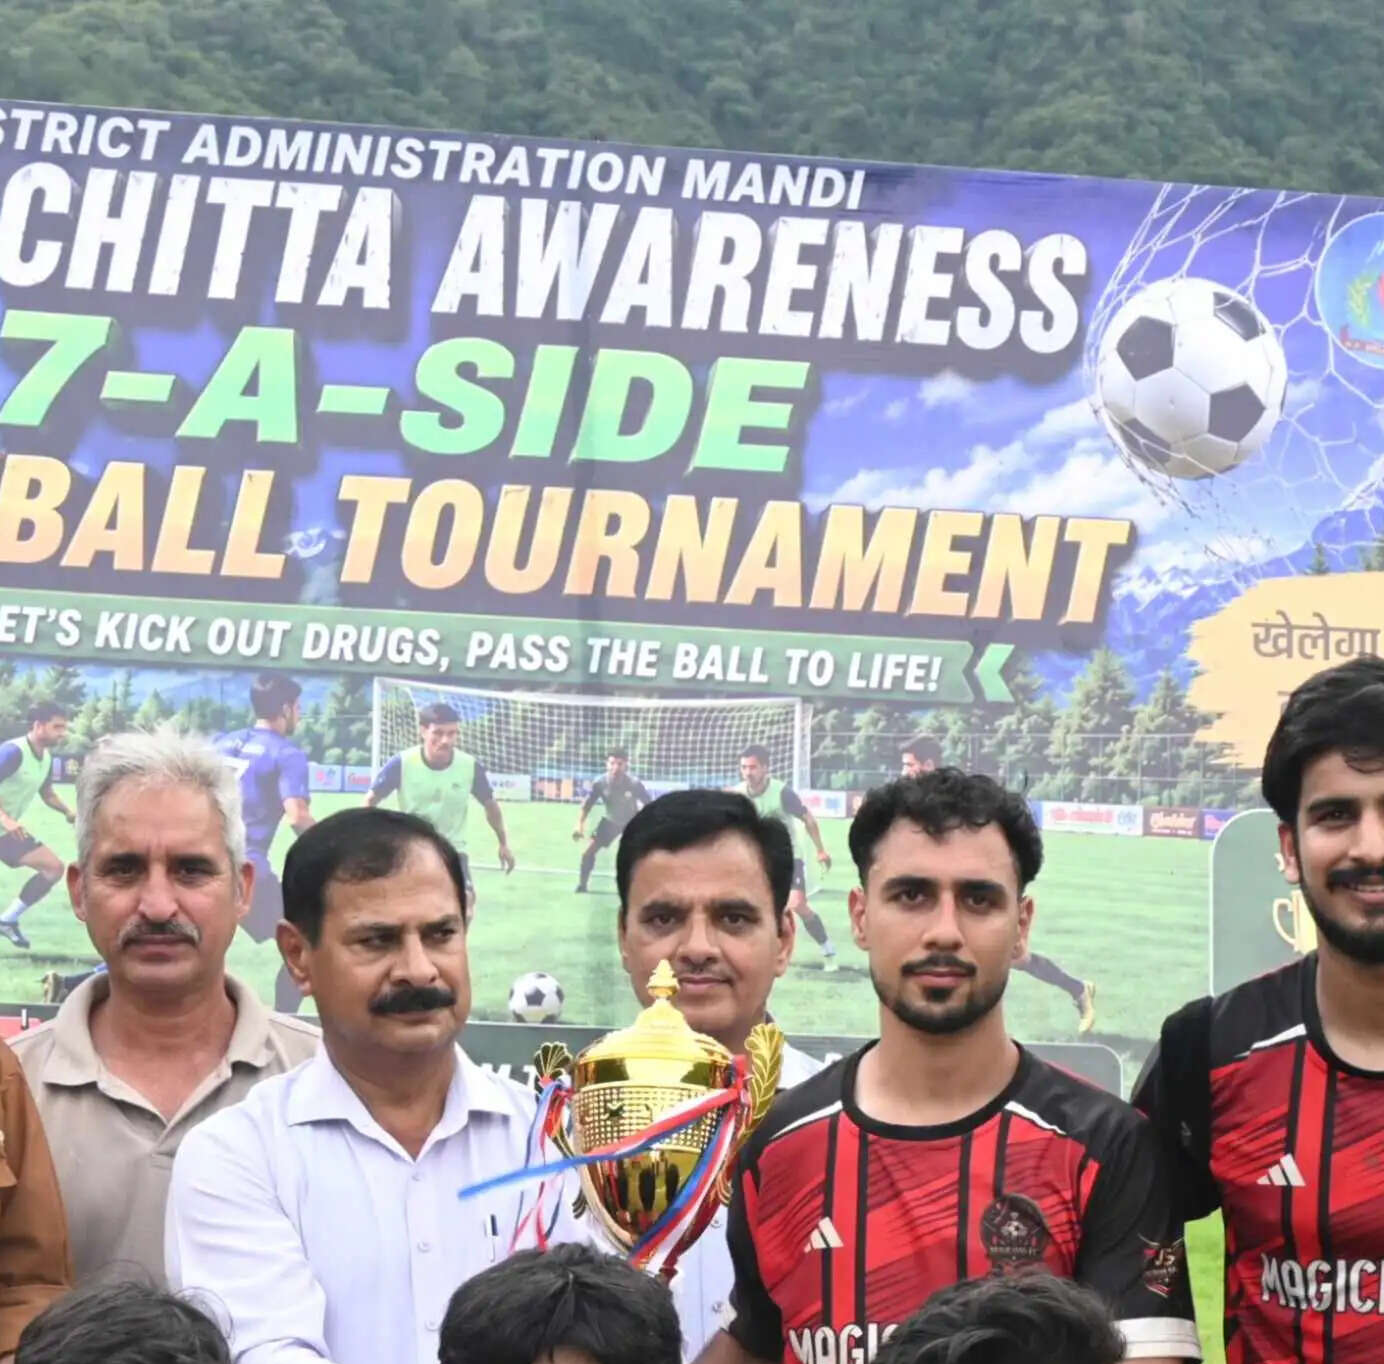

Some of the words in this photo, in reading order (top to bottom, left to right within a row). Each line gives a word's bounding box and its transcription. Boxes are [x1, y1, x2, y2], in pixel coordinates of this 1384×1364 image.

[182, 116, 668, 197] ADMINISTRATION
[682, 156, 866, 210] MANDI
[432, 192, 1089, 355] AWARENESS
[338, 475, 1131, 624] TOURNAMENT
[94, 610, 196, 653] KICK
[207, 618, 292, 658] OUT
[302, 622, 450, 672] DRUGS,
[466, 632, 571, 673] PASS
[587, 637, 661, 677] THE
[672, 642, 770, 684] BALL
[785, 648, 835, 687] TO
[847, 652, 943, 692] LIFE!
